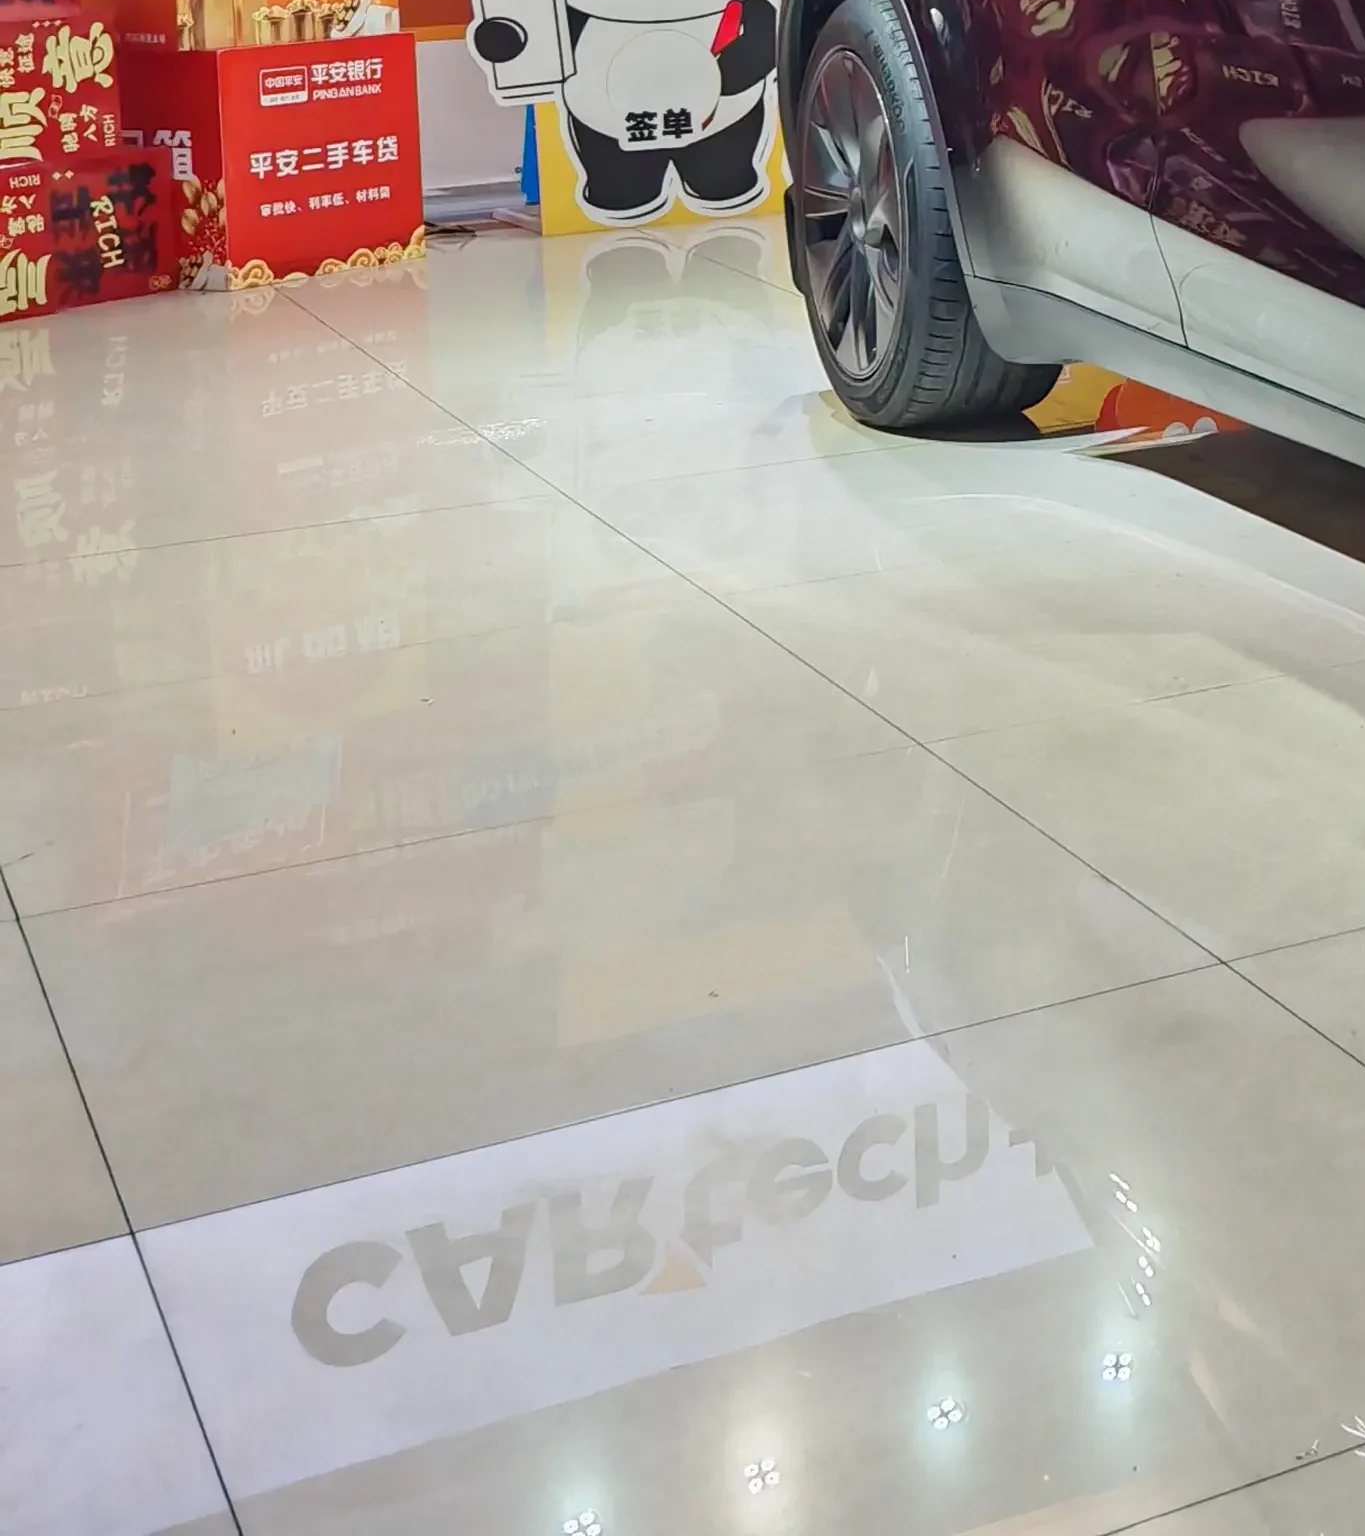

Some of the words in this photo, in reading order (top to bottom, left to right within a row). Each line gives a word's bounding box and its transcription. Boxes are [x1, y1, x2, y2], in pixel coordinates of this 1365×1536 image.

[311, 57, 383, 84] 平安银行
[624, 106, 694, 143] 签单
[250, 135, 399, 180] 平安二手车贷
